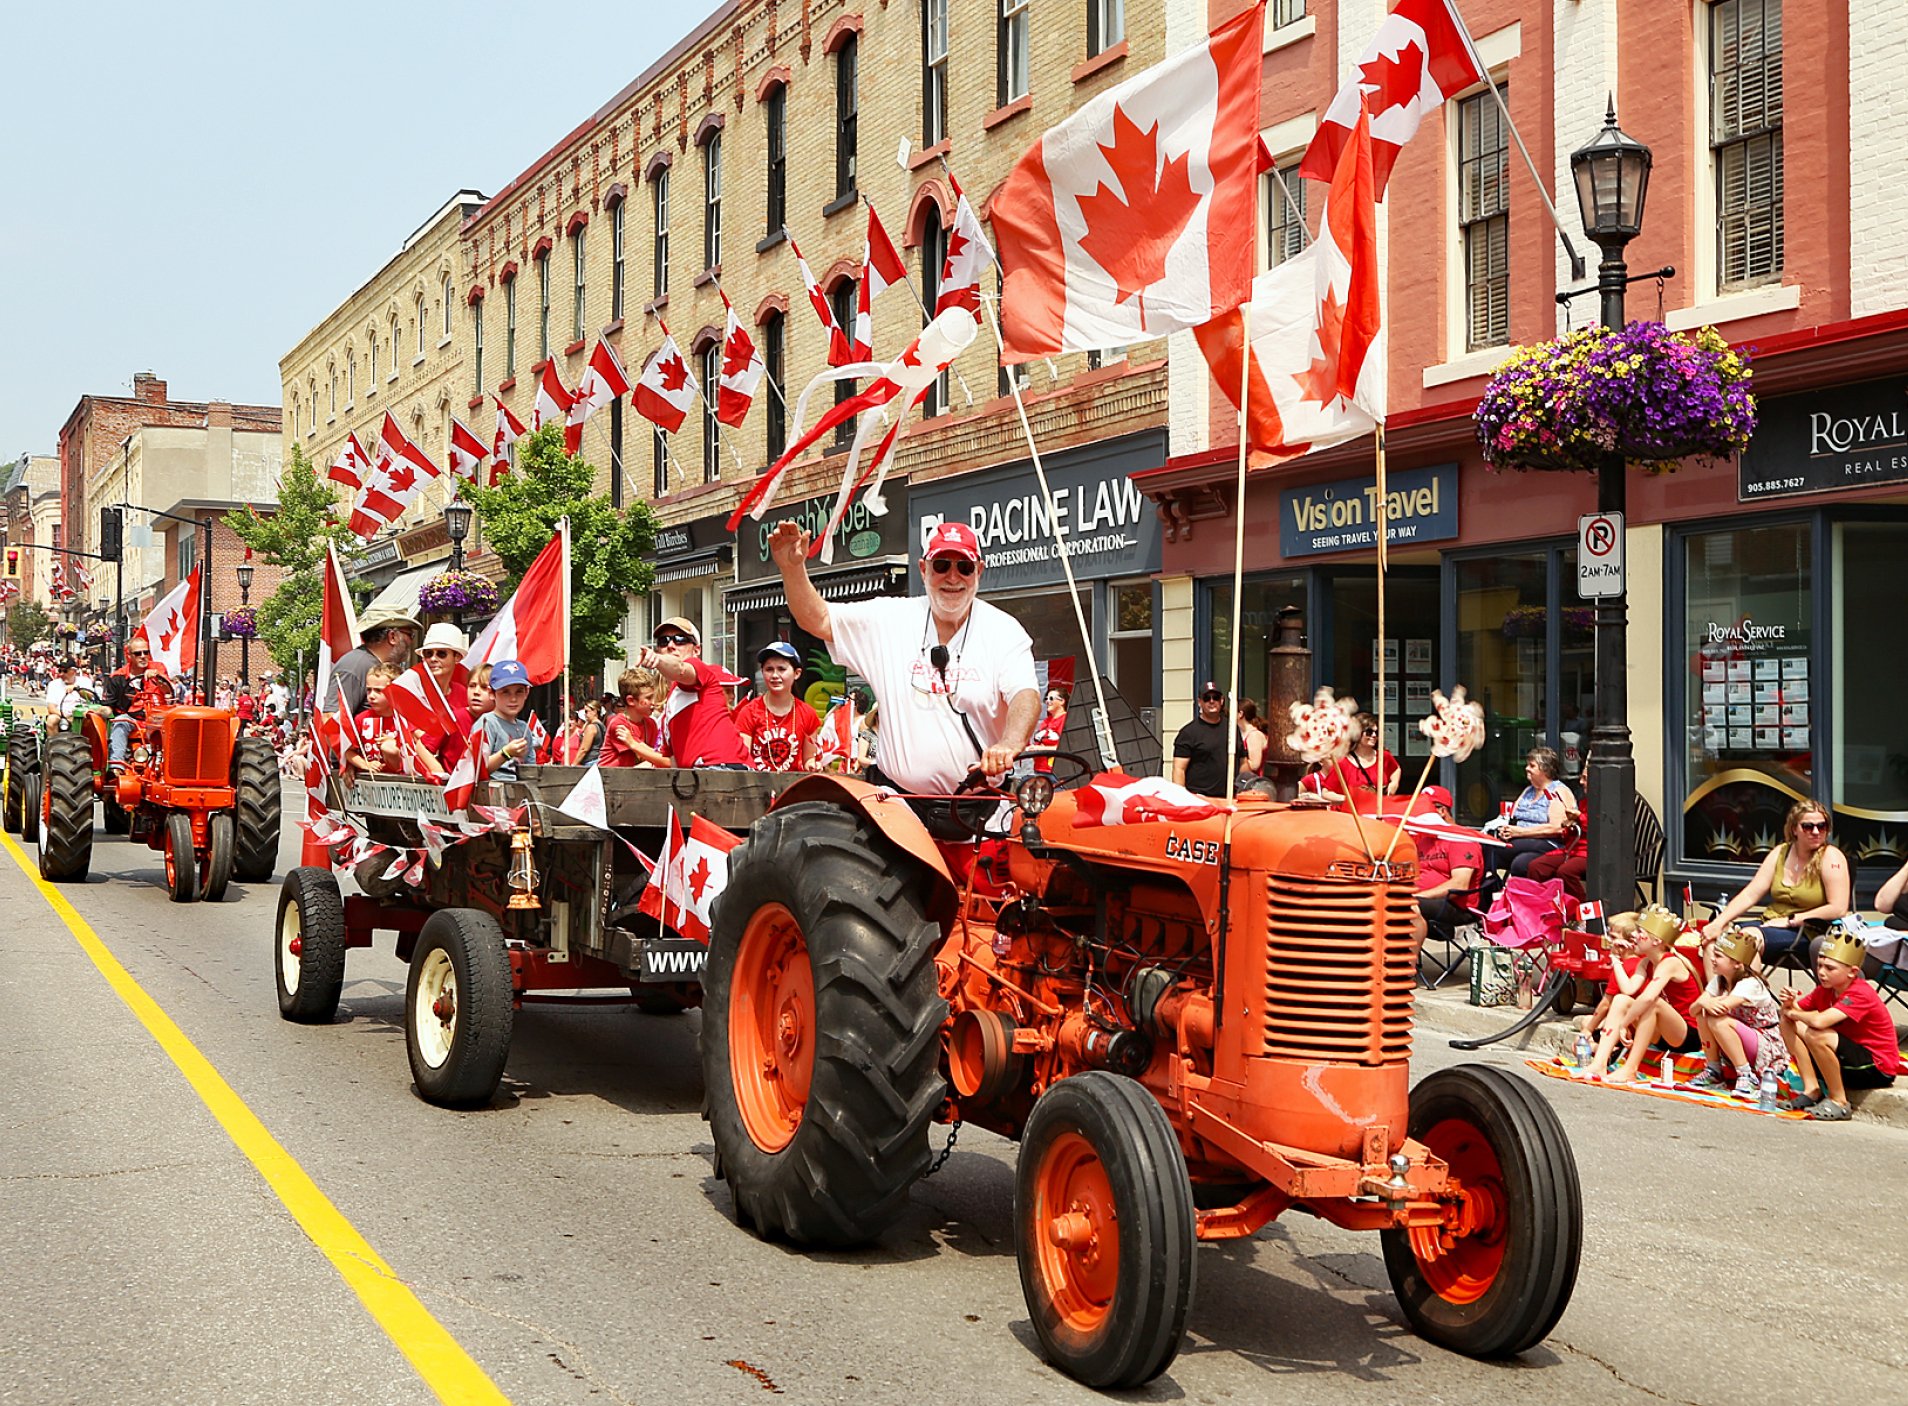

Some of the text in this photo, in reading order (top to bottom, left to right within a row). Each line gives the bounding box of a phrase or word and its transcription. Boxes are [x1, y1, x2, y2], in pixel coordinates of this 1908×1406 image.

[1809, 411, 1906, 454] ROYAL
[1844, 460, 1882, 475] REAL
[1747, 477, 1805, 493] 905.885.7627
[970, 488, 1070, 548] RACINE
[1078, 476, 1143, 532] LAW
[1292, 476, 1439, 533] Vision Tavel
[1312, 525, 1417, 549] SEEING TRAVEL YUR WAY
[984, 545, 1050, 569] PROFESSIONAL
[758, 726, 788, 745] LOVE
[1166, 836, 1219, 865] CASE
